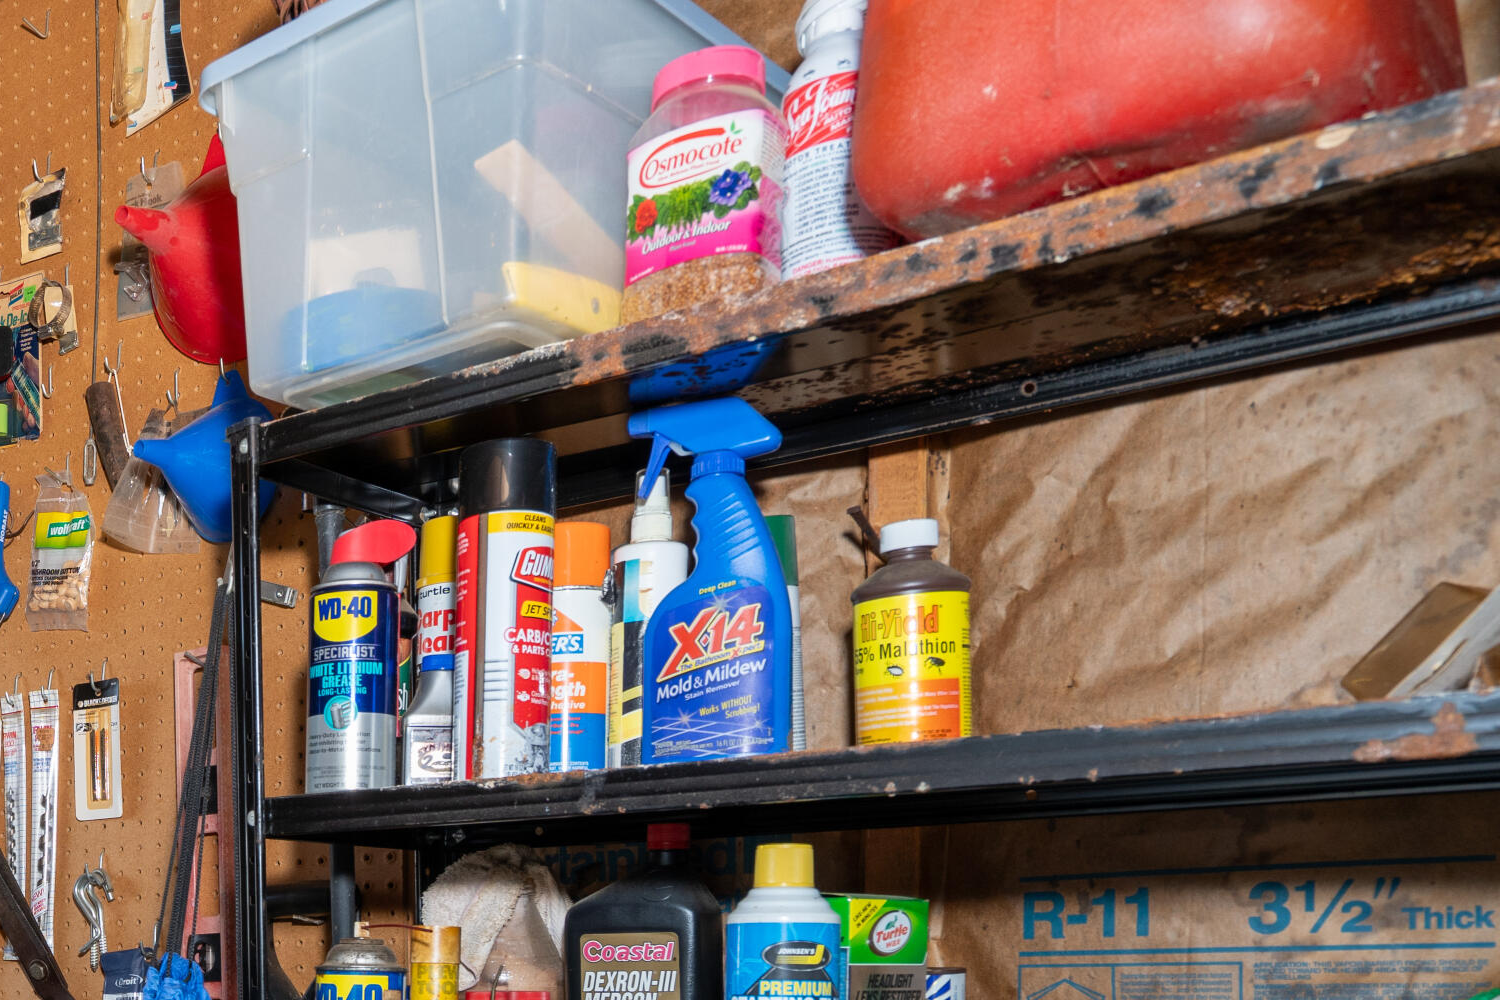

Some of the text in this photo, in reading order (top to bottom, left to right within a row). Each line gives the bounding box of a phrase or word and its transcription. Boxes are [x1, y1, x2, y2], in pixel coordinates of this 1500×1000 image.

[645, 137, 742, 180] Osmocote
[642, 221, 732, 255] Outdoor Indoor
[0, 510, 8, 542] KOBALT
[506, 521, 534, 530] QUICKLY
[524, 514, 546, 524] CLEANS
[699, 580, 736, 595] Deep Clean
[318, 596, 372, 621] WD-40
[525, 604, 540, 615] JET
[861, 605, 939, 643] Hi-Yield
[522, 645, 544, 655] PARTS
[695, 652, 731, 666] Bathroom
[310, 662, 383, 679] WHITE LITHIUM
[656, 658, 766, 703] Mold & Mildew
[322, 675, 362, 688] GREASE
[685, 680, 740, 700] Stain Remover
[700, 695, 753, 716] Works WITHOUT
[1022, 886, 1150, 940] R-11
[1402, 905, 1496, 931] Thick
[876, 924, 908, 944] Turtle
[582, 940, 674, 963] Coastal
[582, 970, 677, 992] DEXRON-III
[759, 980, 832, 996] PREMIUM
[868, 974, 914, 989] HEADLIGHT
